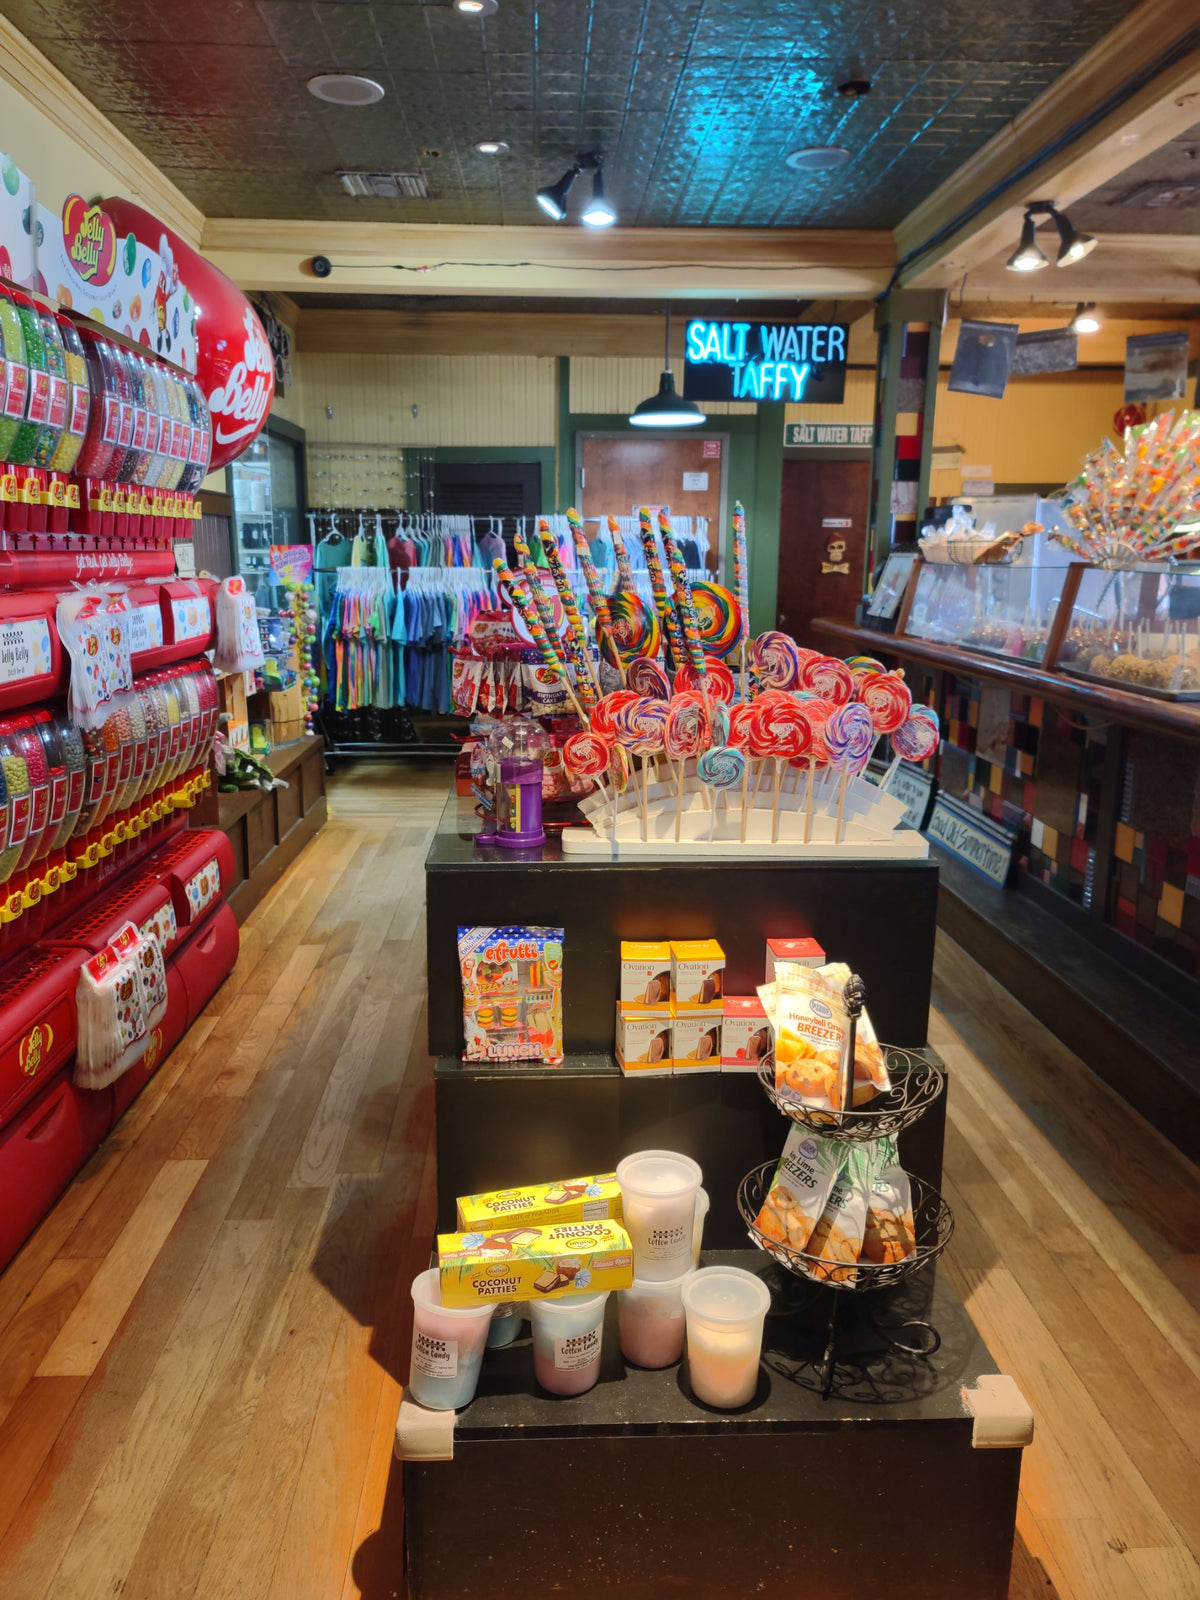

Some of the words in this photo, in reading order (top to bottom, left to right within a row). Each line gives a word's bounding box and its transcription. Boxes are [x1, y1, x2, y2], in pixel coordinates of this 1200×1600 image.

[81, 205, 104, 252] Jelly
[71, 232, 99, 281] Belly
[687, 321, 750, 363] SALT
[760, 325, 845, 362] WATER
[728, 361, 810, 400] TAFFY
[208, 361, 269, 445] Belly
[793, 426, 815, 443] SALT
[817, 426, 848, 444] WATER
[850, 426, 873, 444] TAFF
[1, 648, 14, 666] Jelly
[15, 645, 29, 663] Belly
[485, 941, 539, 962] efrutti
[623, 962, 655, 971] Ovation
[678, 962, 709, 971] Ovation
[675, 1019, 706, 1030] Ovation
[724, 1018, 756, 1028] Ovation
[789, 1012, 826, 1027] Honeybell
[626, 1022, 657, 1032] Ovation
[487, 1043, 541, 1059] LUNCH
[797, 1156, 815, 1175] Lime
[485, 1195, 537, 1208] COCONUT
[492, 1201, 534, 1213] PATTIES
[548, 1228, 611, 1239] COCONUT
[553, 1223, 603, 1233] PATTIES
[472, 1276, 522, 1288] COCONUT
[478, 1284, 517, 1295] PATTIES
